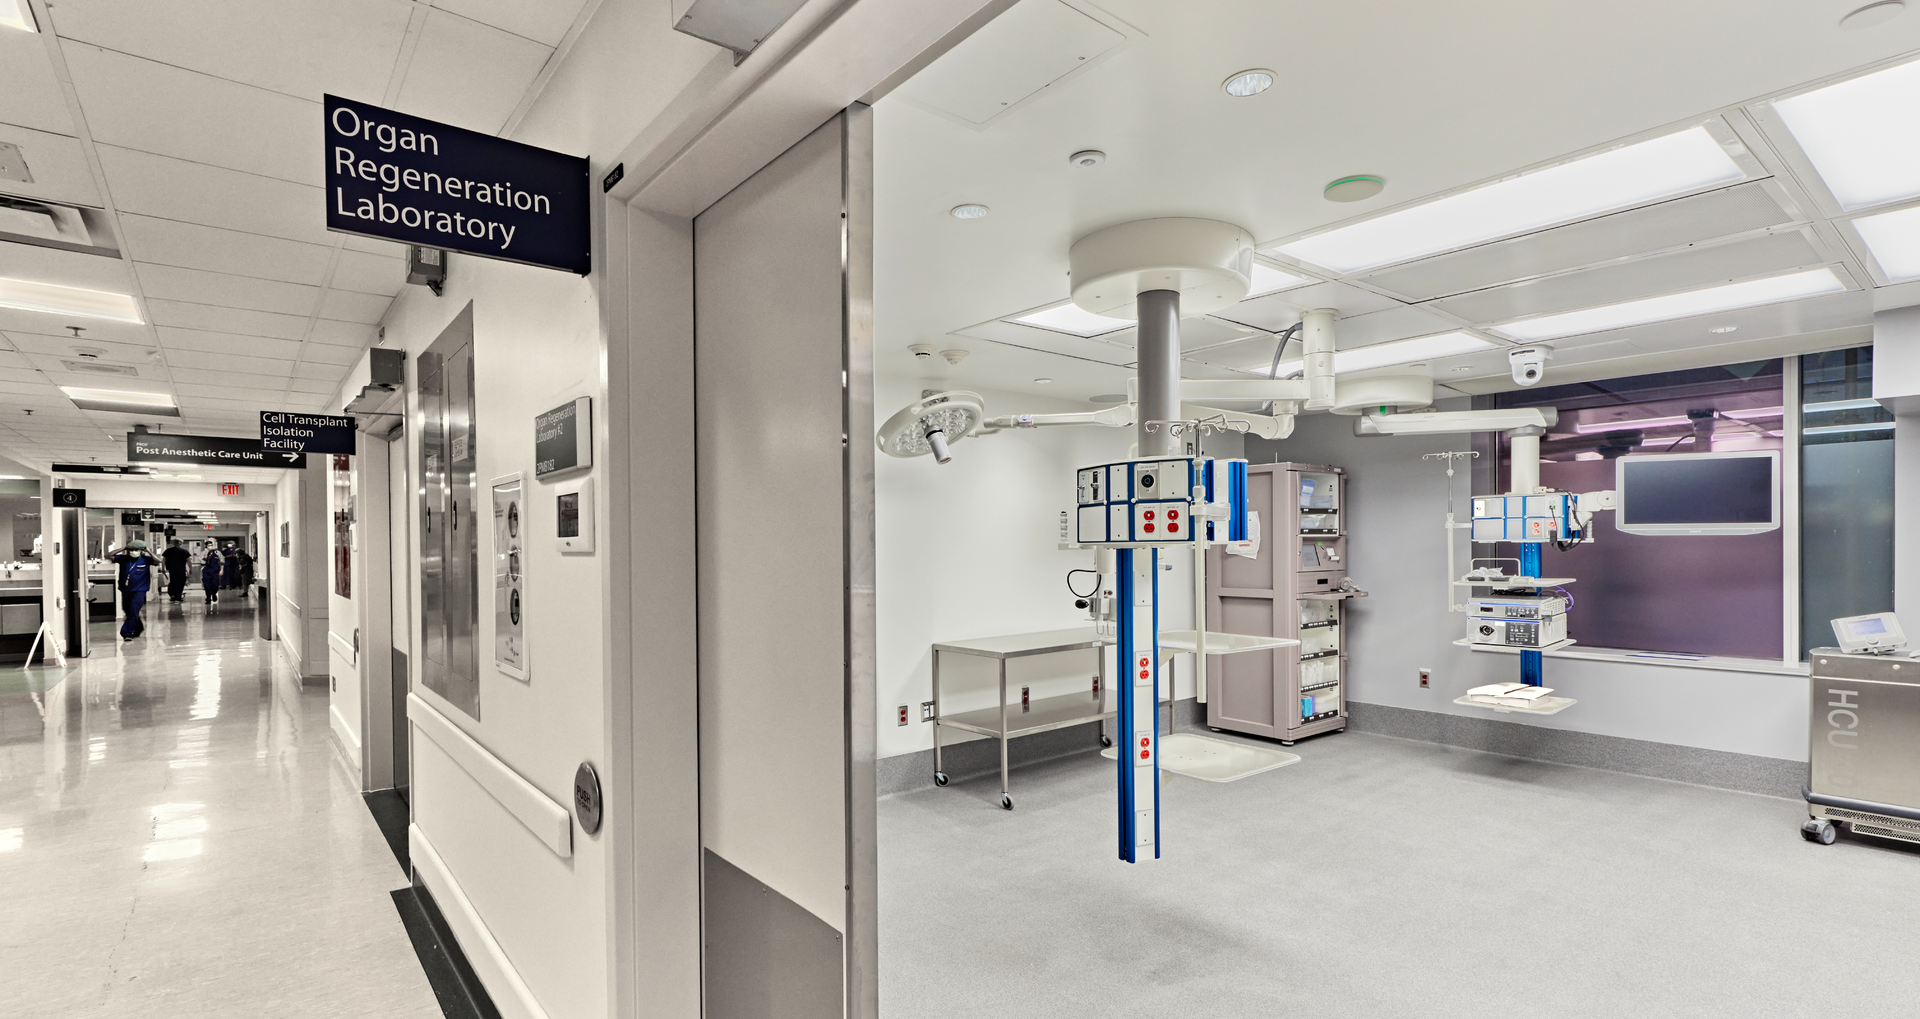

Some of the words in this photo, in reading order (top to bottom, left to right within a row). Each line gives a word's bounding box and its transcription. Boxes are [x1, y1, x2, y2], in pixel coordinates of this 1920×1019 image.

[332, 107, 439, 155] Organ
[334, 146, 550, 215] Regeneration
[336, 186, 516, 250] Laboratory
[262, 413, 285, 424] Cell
[287, 414, 348, 428] Transplant
[536, 417, 548, 430] Organ
[548, 405, 576, 426] Regeneration
[263, 425, 314, 438] Isolation
[536, 428, 557, 443] Laboratory
[136, 446, 159, 455] Post
[161, 447, 217, 458] Anesthetic
[218, 450, 241, 459] Care
[242, 451, 263, 460] Unit
[263, 438, 305, 451] Facility
[222, 484, 239, 496] EXIT
[1827, 688, 1859, 750] HCU
[576, 785, 591, 805] PUSH
